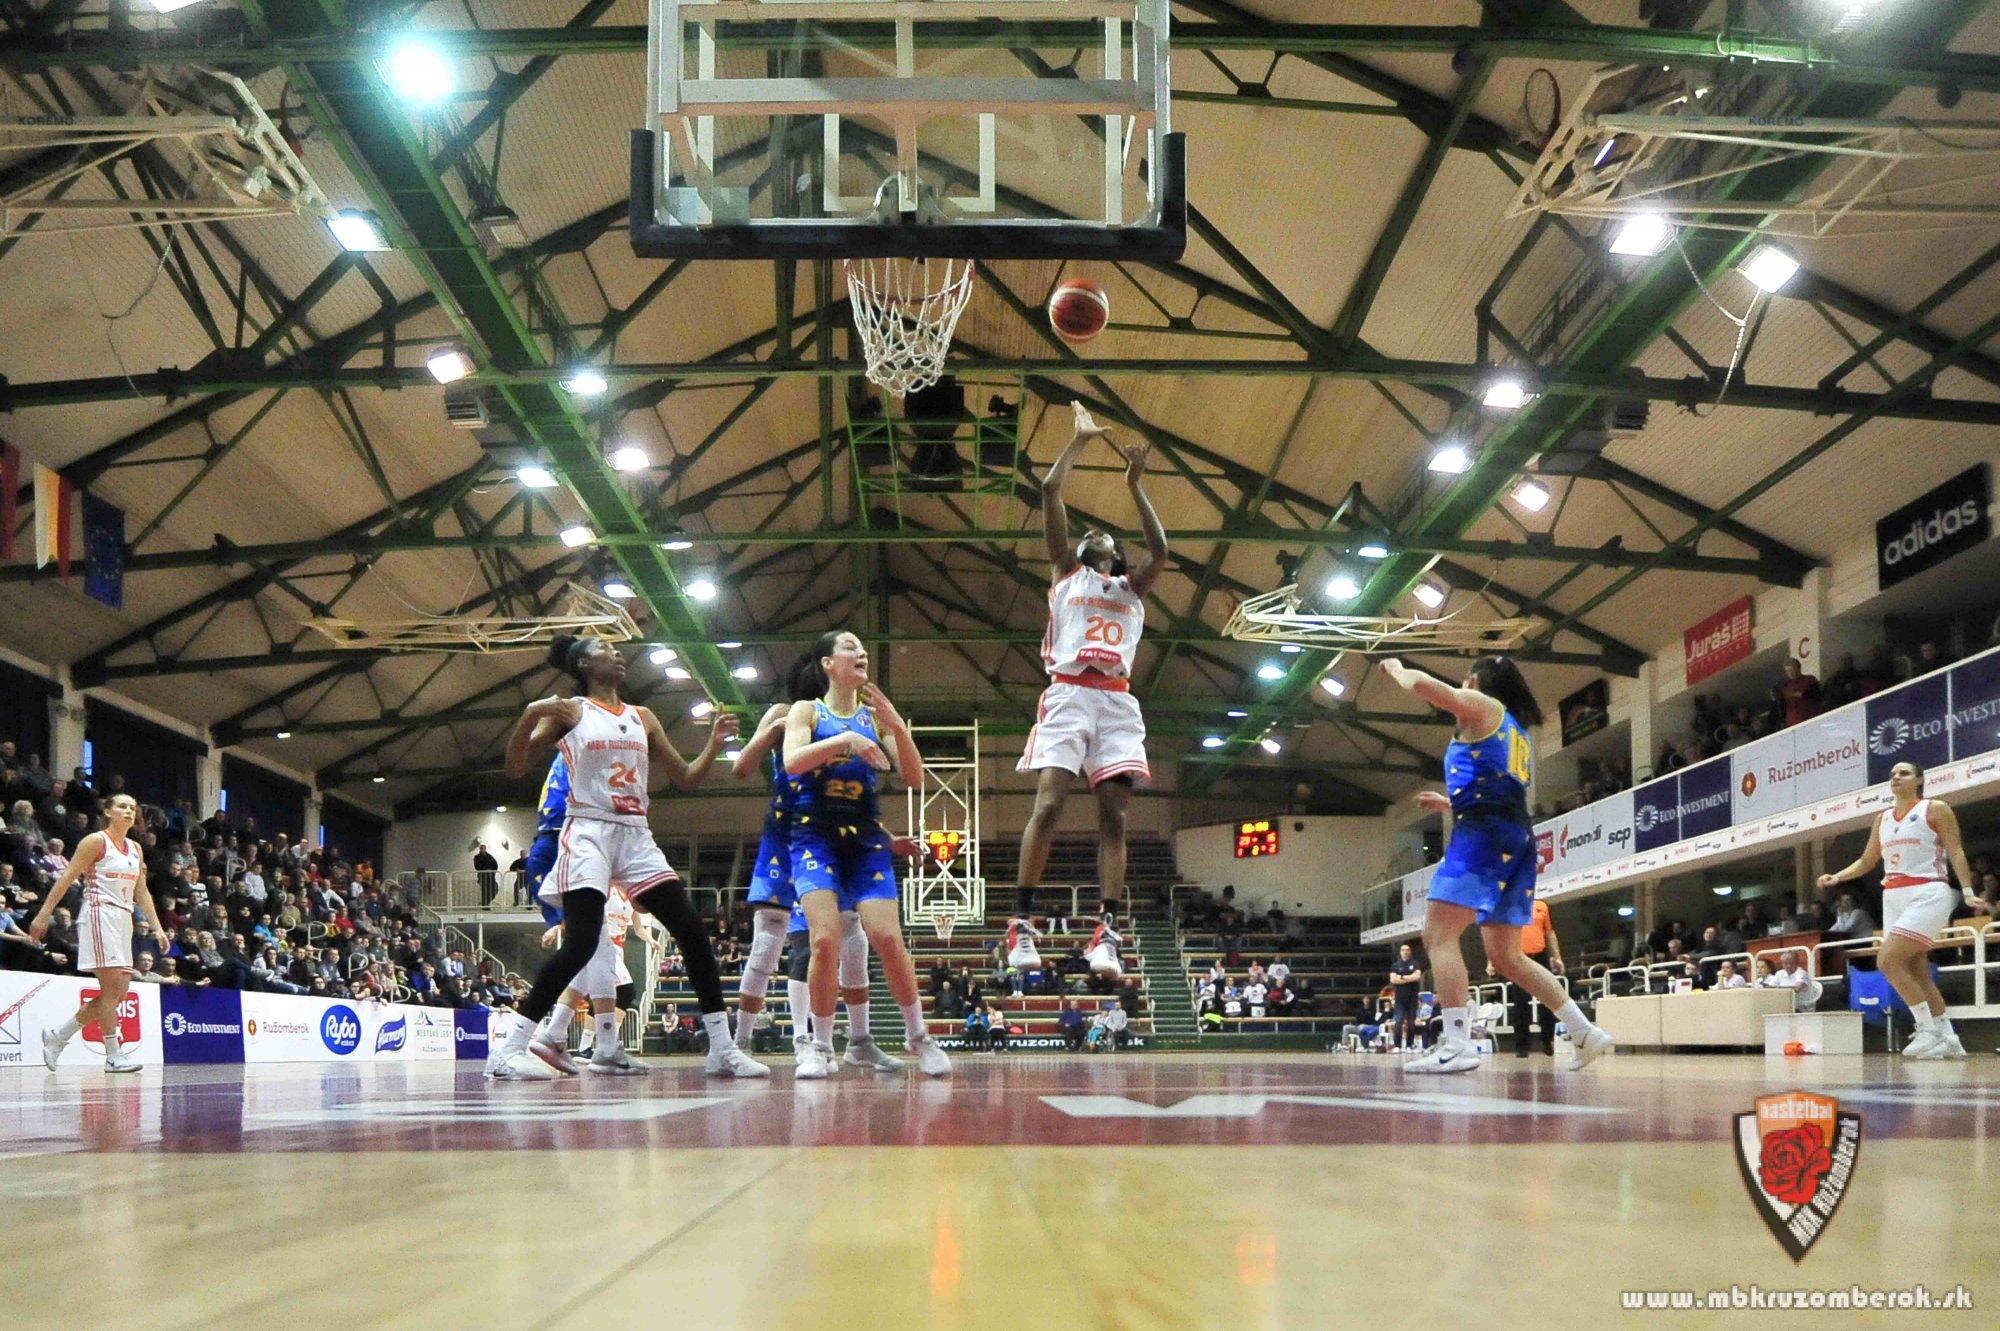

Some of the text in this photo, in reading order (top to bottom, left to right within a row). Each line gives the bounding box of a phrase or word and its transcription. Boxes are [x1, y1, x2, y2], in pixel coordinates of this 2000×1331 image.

[1884, 499, 1979, 566] adidas
[1084, 615, 1123, 646] 20
[1687, 619, 1732, 664] Juráš
[1913, 698, 2000, 741] ECO INVEST
[1768, 742, 1862, 785] Ružomberok
[825, 779, 864, 801] 23
[1567, 824, 1603, 851] mondi
[1608, 826, 1632, 850] scp
[187, 1022, 241, 1035] ECO INVESTMENT
[262, 1020, 310, 1035] Ružomberok
[325, 1014, 357, 1046] Ryba
